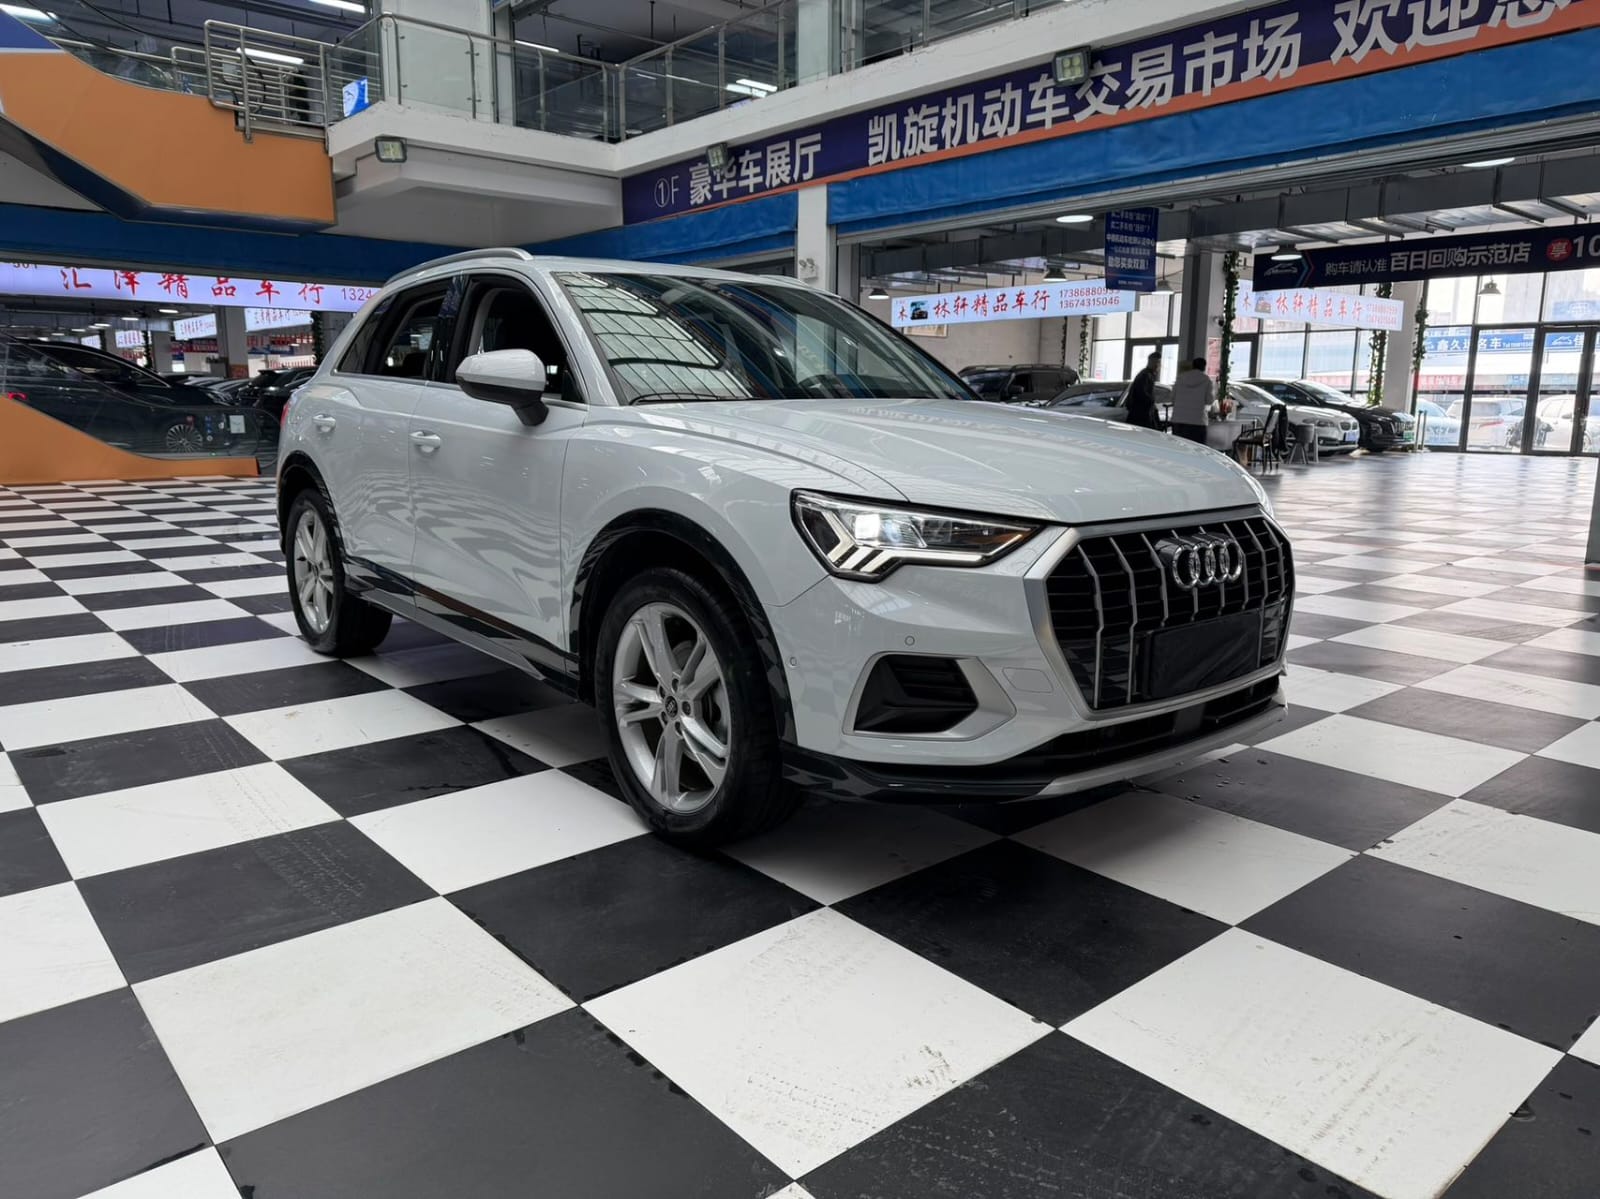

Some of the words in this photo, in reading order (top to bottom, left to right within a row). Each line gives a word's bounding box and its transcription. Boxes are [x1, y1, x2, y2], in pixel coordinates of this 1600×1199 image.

[867, 12, 1301, 167] 凯旋机动车交易市场
[689, 133, 822, 205] 豪华车展厅
[1324, 258, 1387, 276] 购车请认准
[1390, 241, 1531, 271] 百日回购示范店
[933, 289, 1051, 319] 林轩精品车行
[1059, 296, 1121, 309] 13674315046
